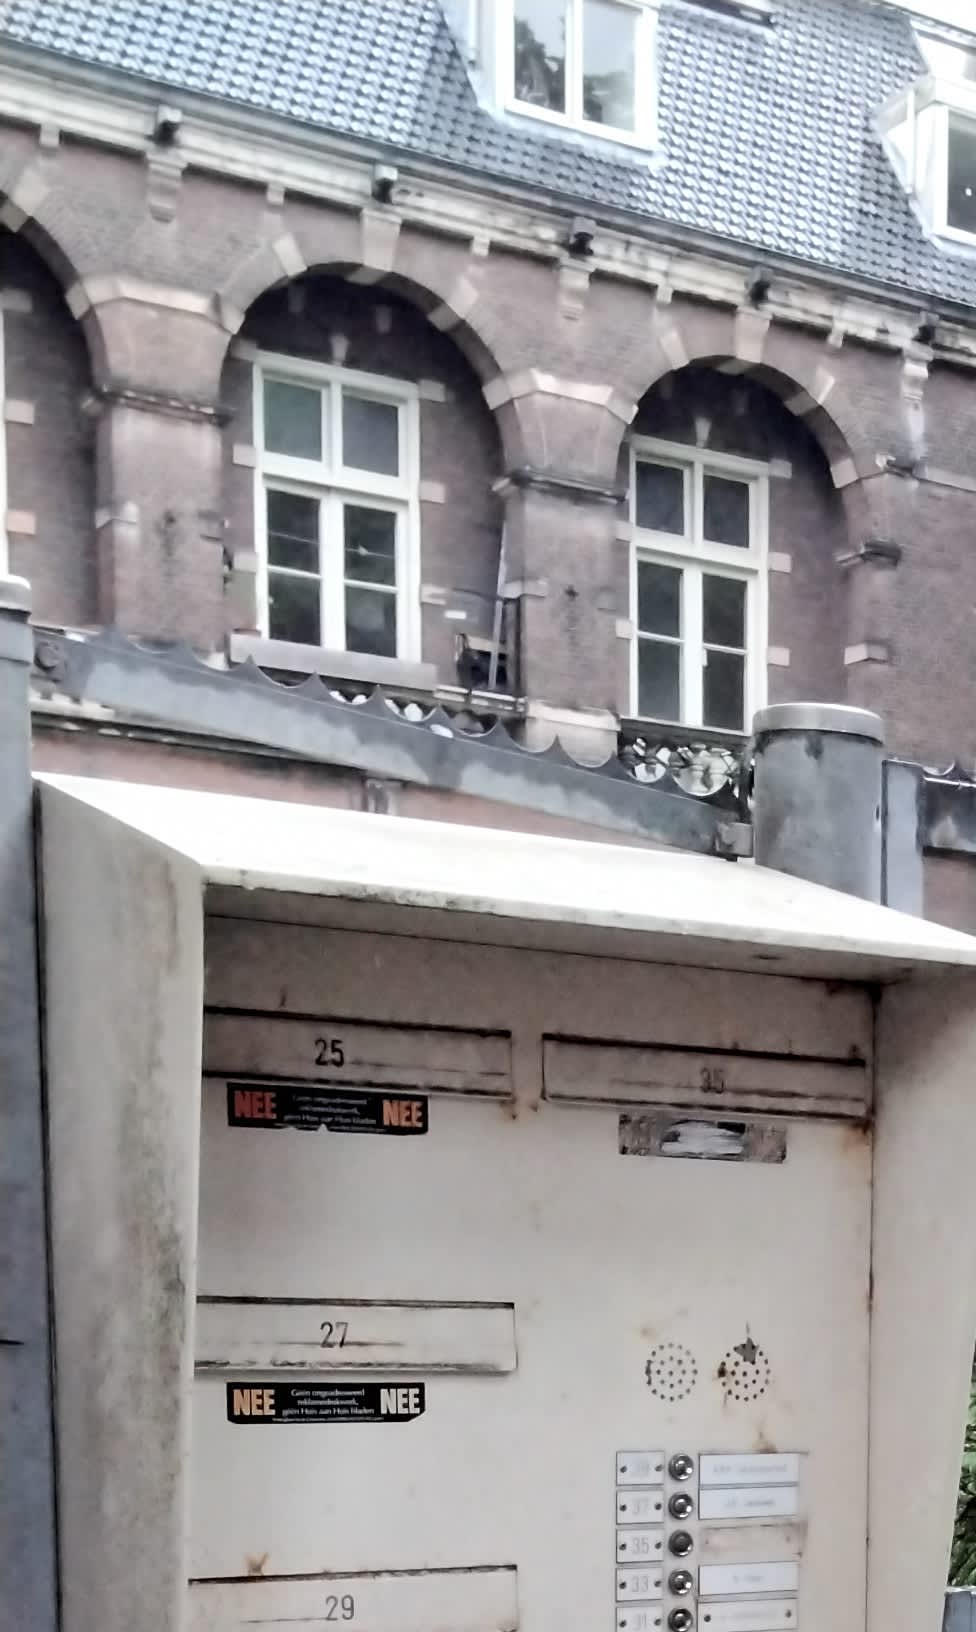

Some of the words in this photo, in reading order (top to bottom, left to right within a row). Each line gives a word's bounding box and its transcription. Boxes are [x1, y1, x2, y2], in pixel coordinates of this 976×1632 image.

[315, 1037, 345, 1067] 25
[234, 1090, 277, 1119] NEE
[383, 1099, 424, 1128] NEE
[320, 1321, 349, 1348] 27
[233, 1389, 275, 1416] NEE
[380, 1388, 420, 1414] NEE
[631, 1537, 649, 1554] 35
[631, 1575, 649, 1592] 33
[325, 1594, 355, 1621] 29
